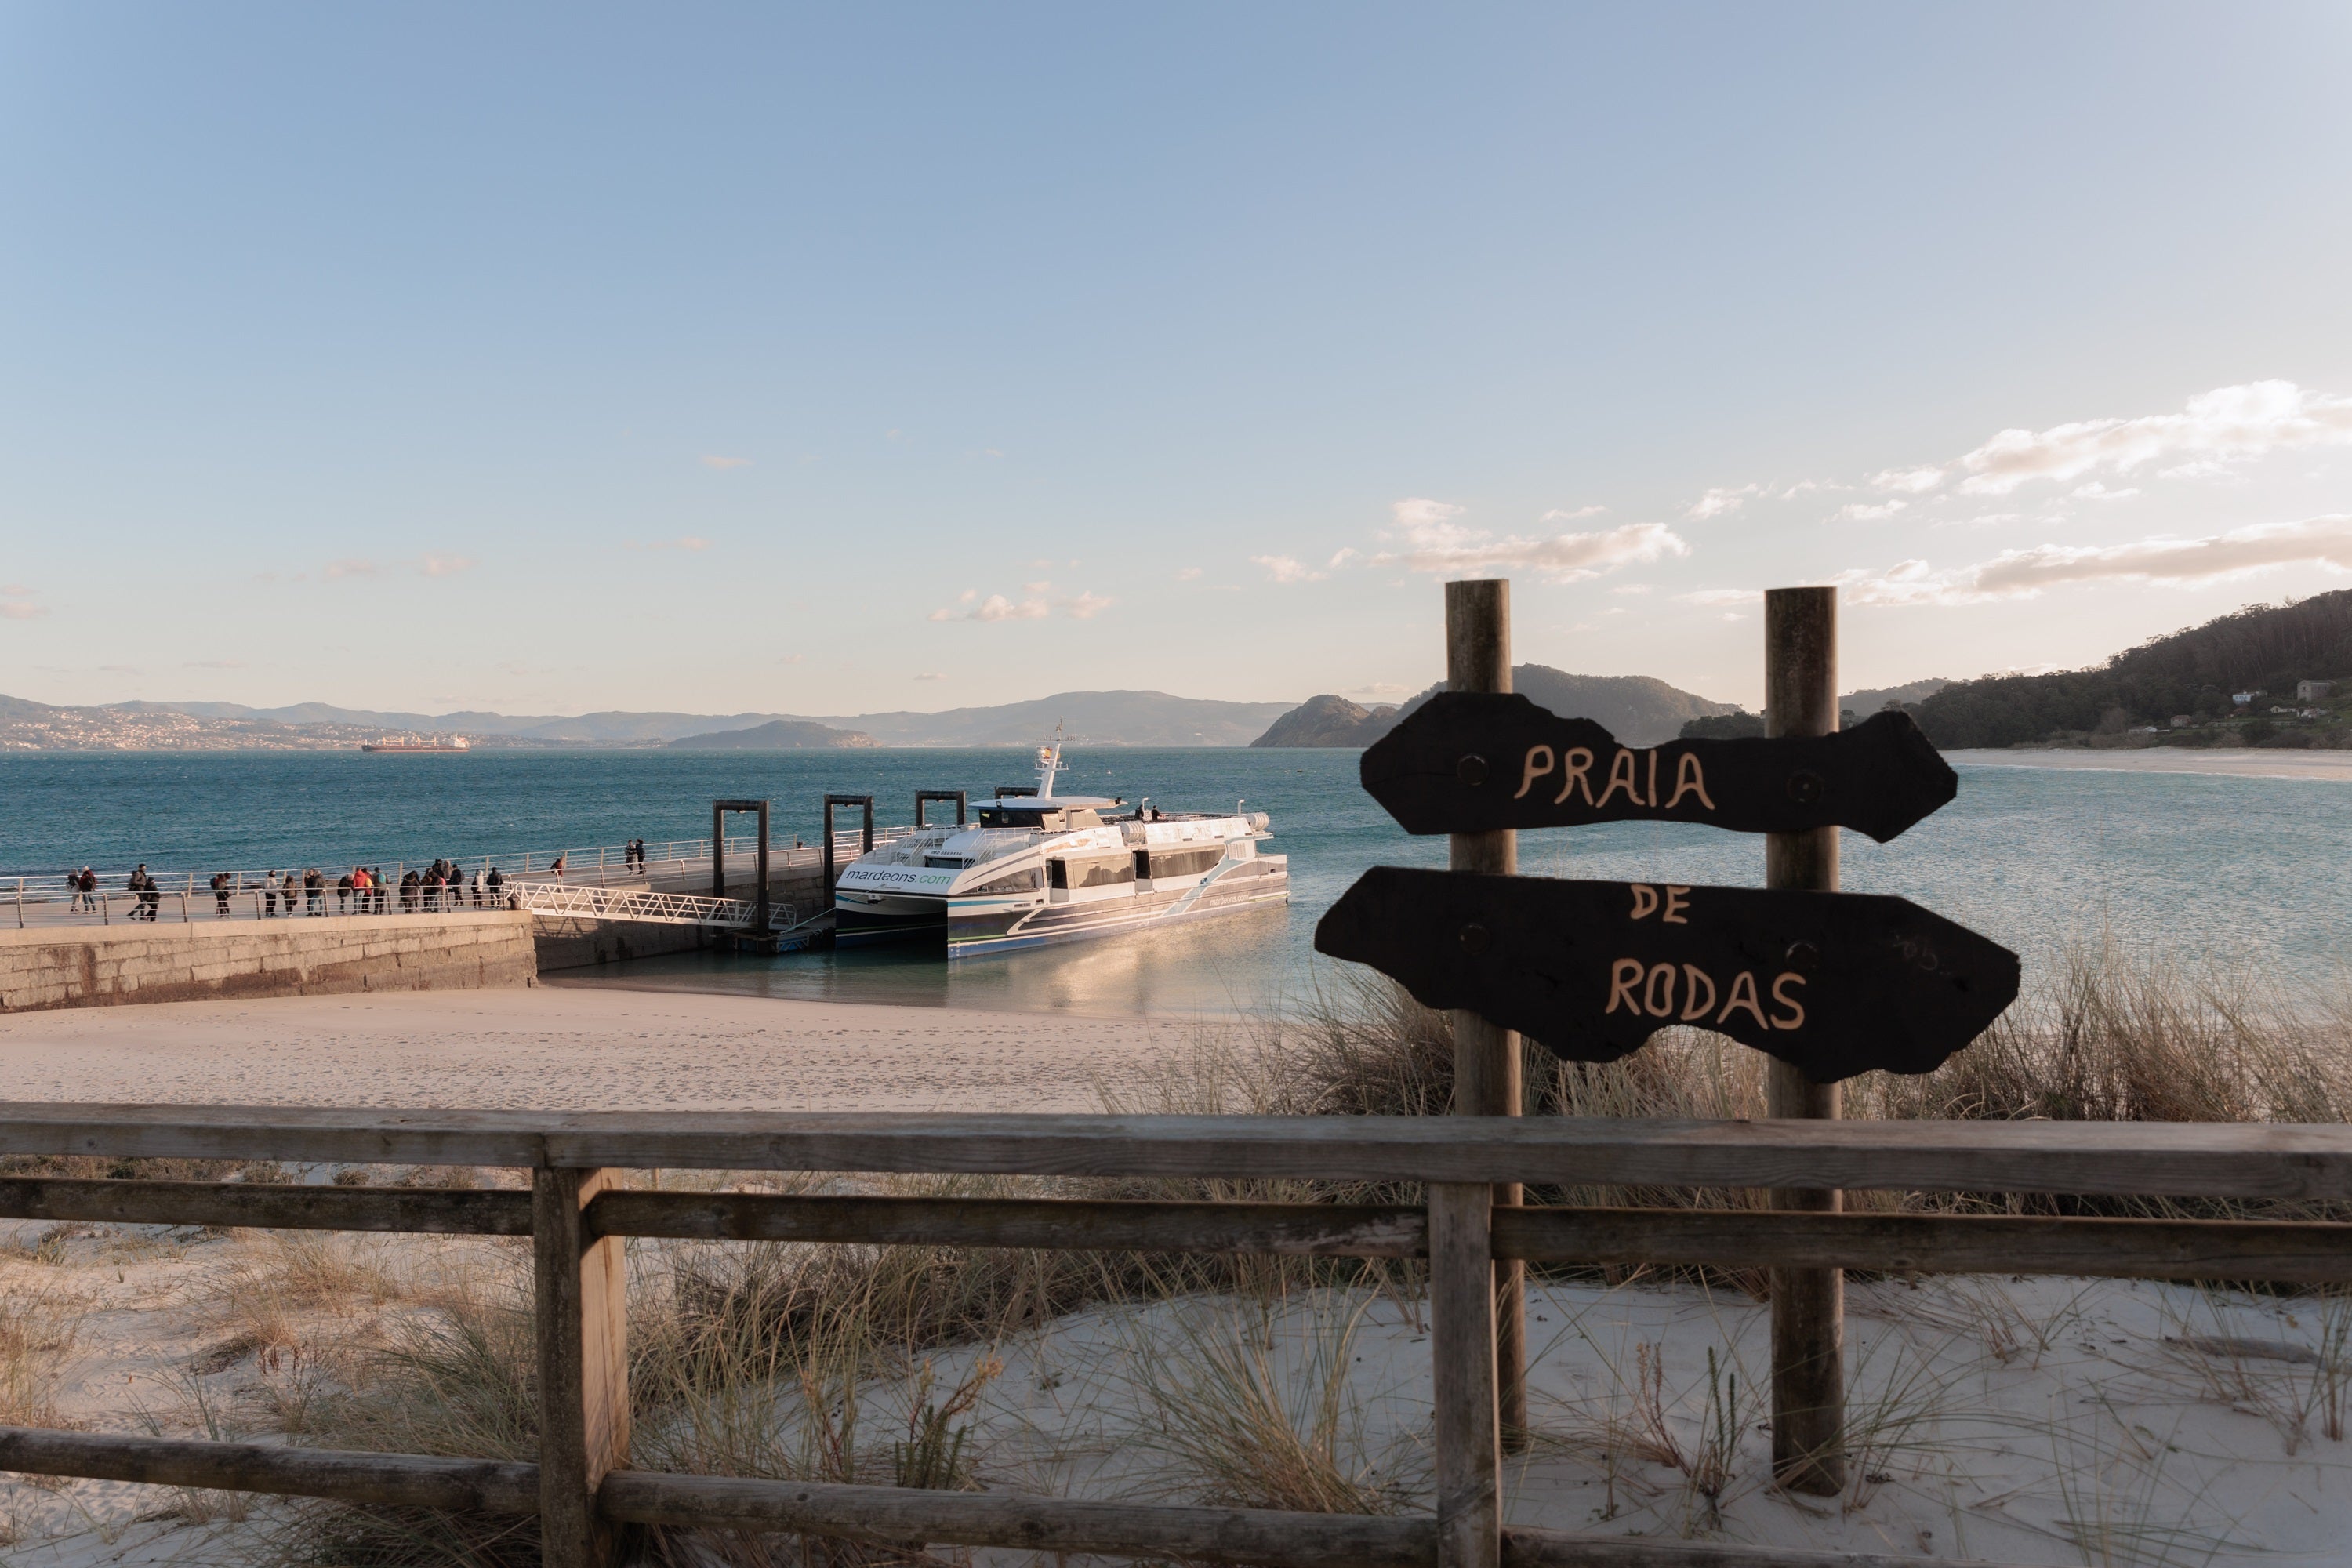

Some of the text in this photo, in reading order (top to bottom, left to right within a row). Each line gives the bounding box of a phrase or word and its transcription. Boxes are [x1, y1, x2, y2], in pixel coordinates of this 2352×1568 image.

[1515, 745, 1715, 810] PRAIA
[845, 869, 951, 885] mardeons.com
[1210, 894, 1249, 906] mardeons.com
[1630, 884, 1691, 924] DE
[1606, 959, 1806, 1029] RODAS
